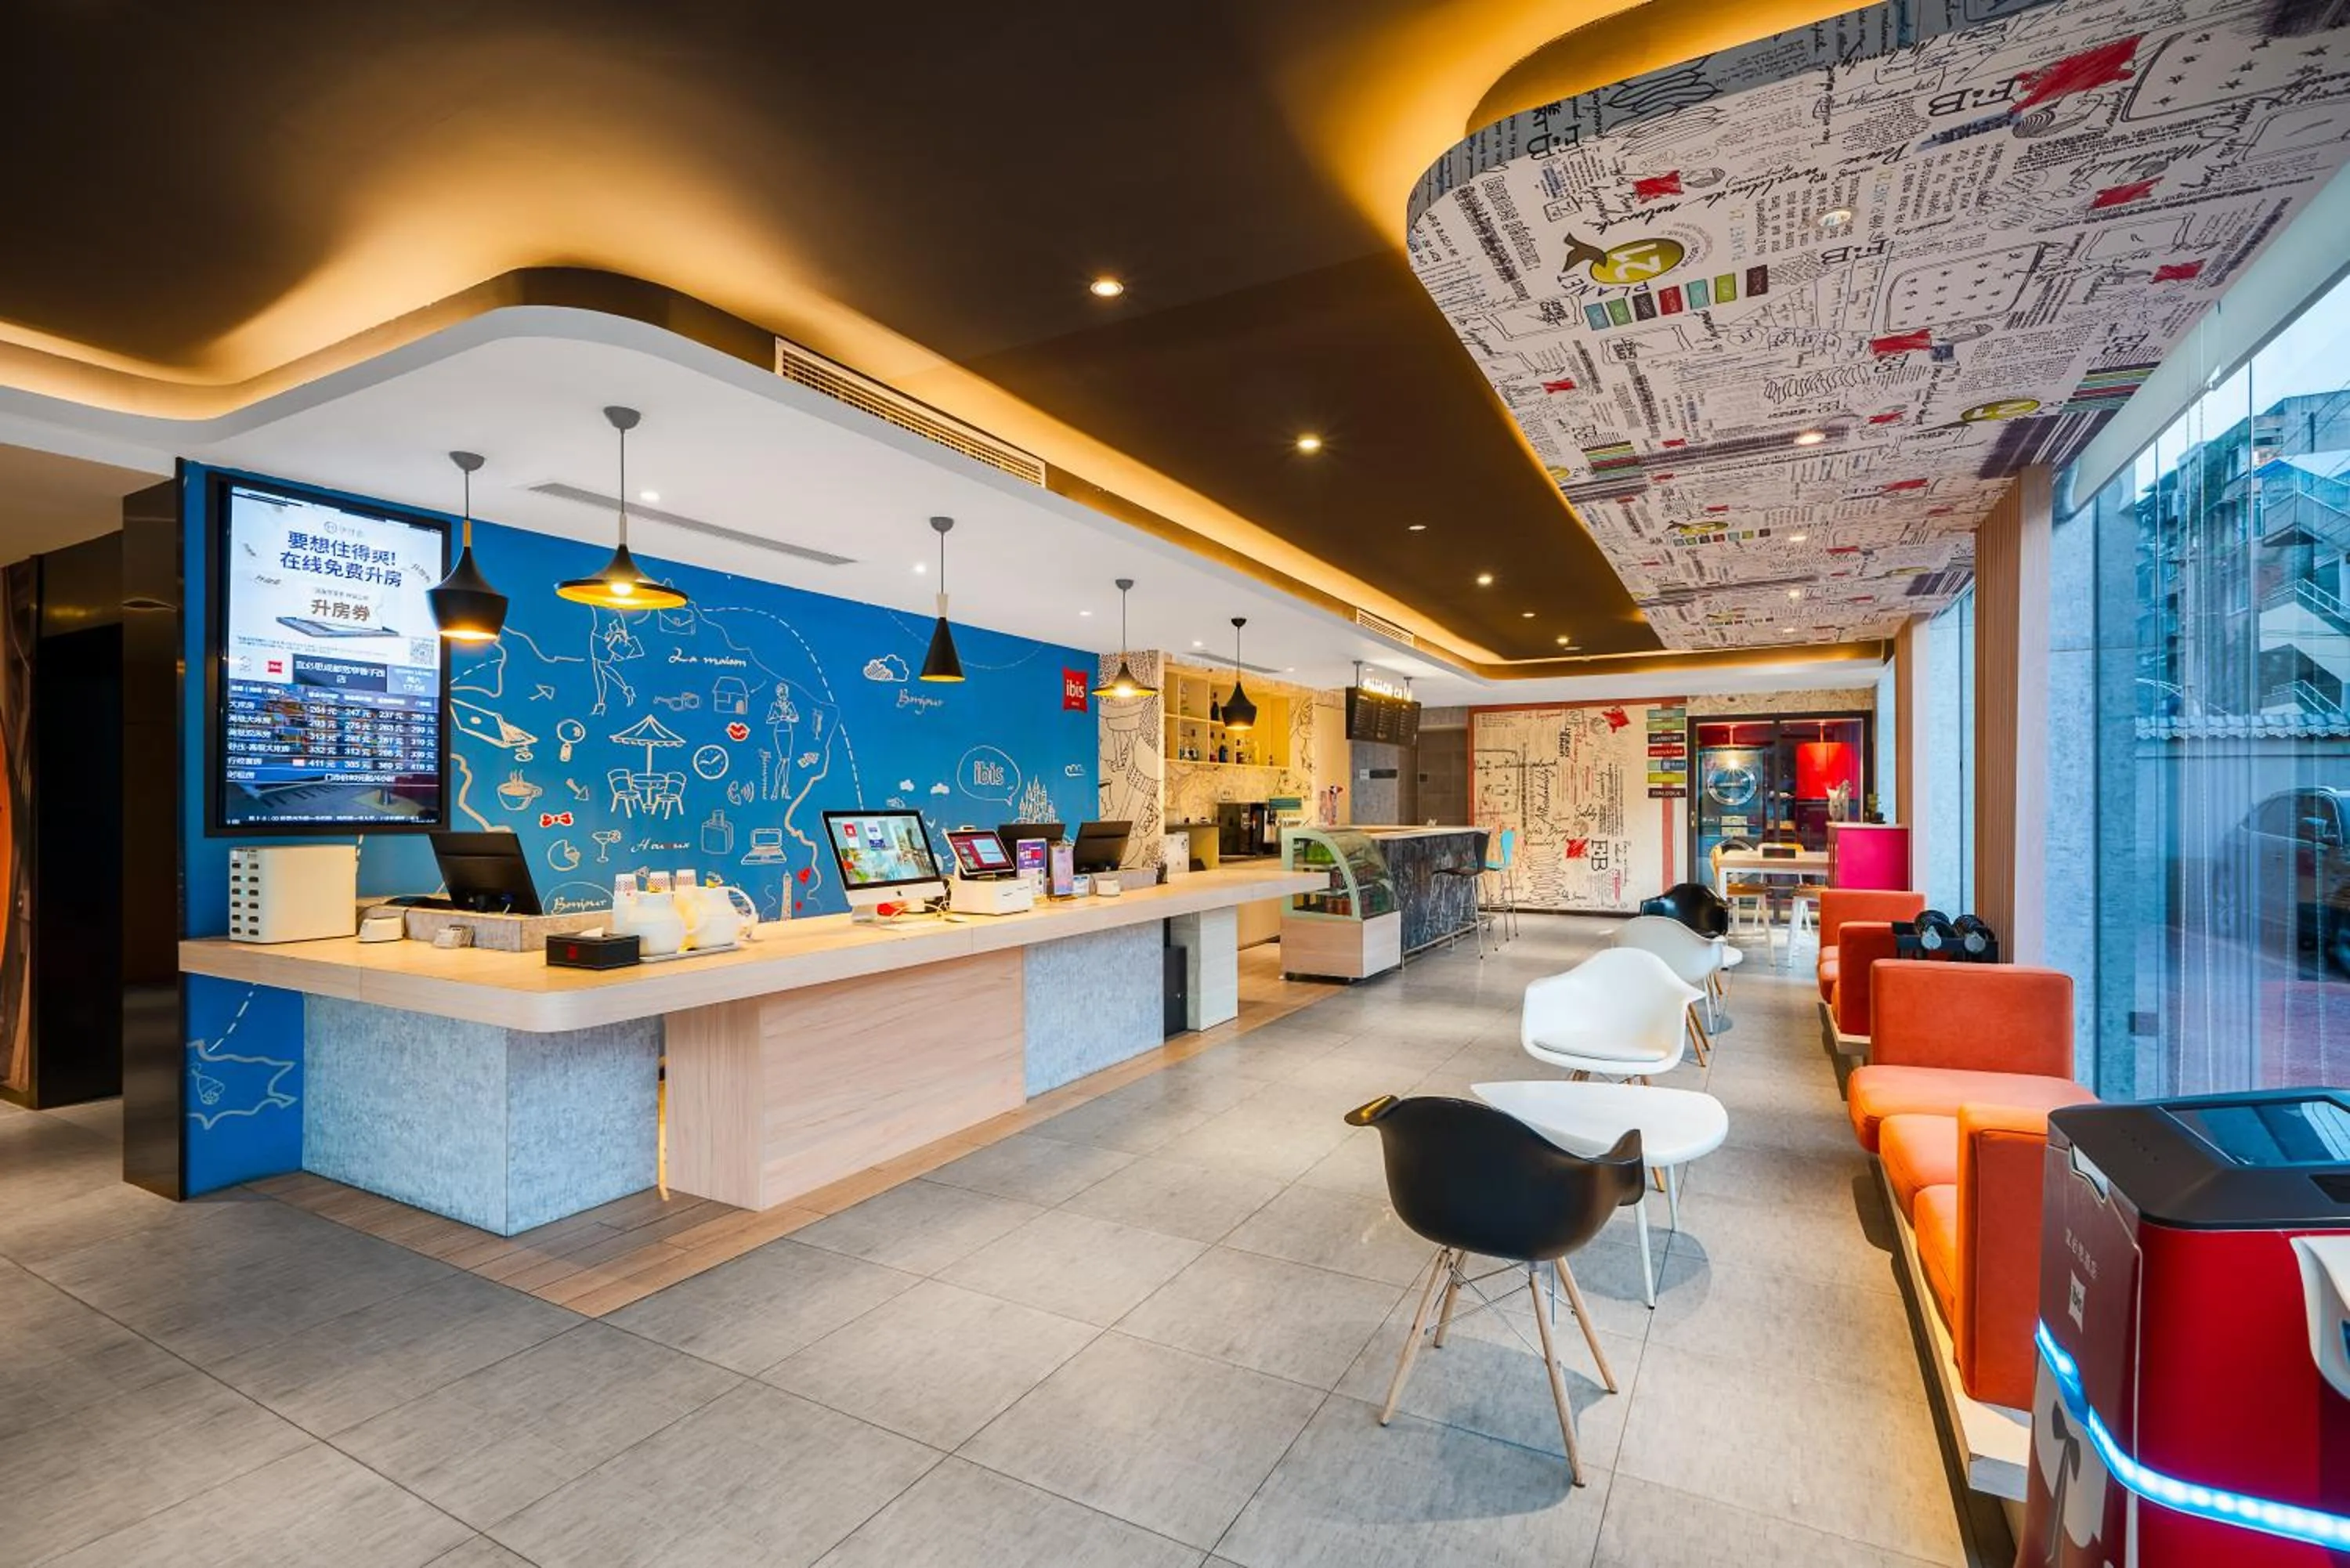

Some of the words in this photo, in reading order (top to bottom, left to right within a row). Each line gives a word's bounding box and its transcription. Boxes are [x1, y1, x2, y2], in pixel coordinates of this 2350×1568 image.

[1613, 243, 1661, 280] 21
[1557, 273, 1649, 298] PLANET
[288, 530, 396, 566] 要想住得爽!
[280, 551, 402, 587] 在线免费升房
[311, 598, 371, 621] 升房券
[896, 688, 945, 714] Bonjour
[1066, 678, 1085, 698] ibis
[974, 760, 1004, 786] ibis
